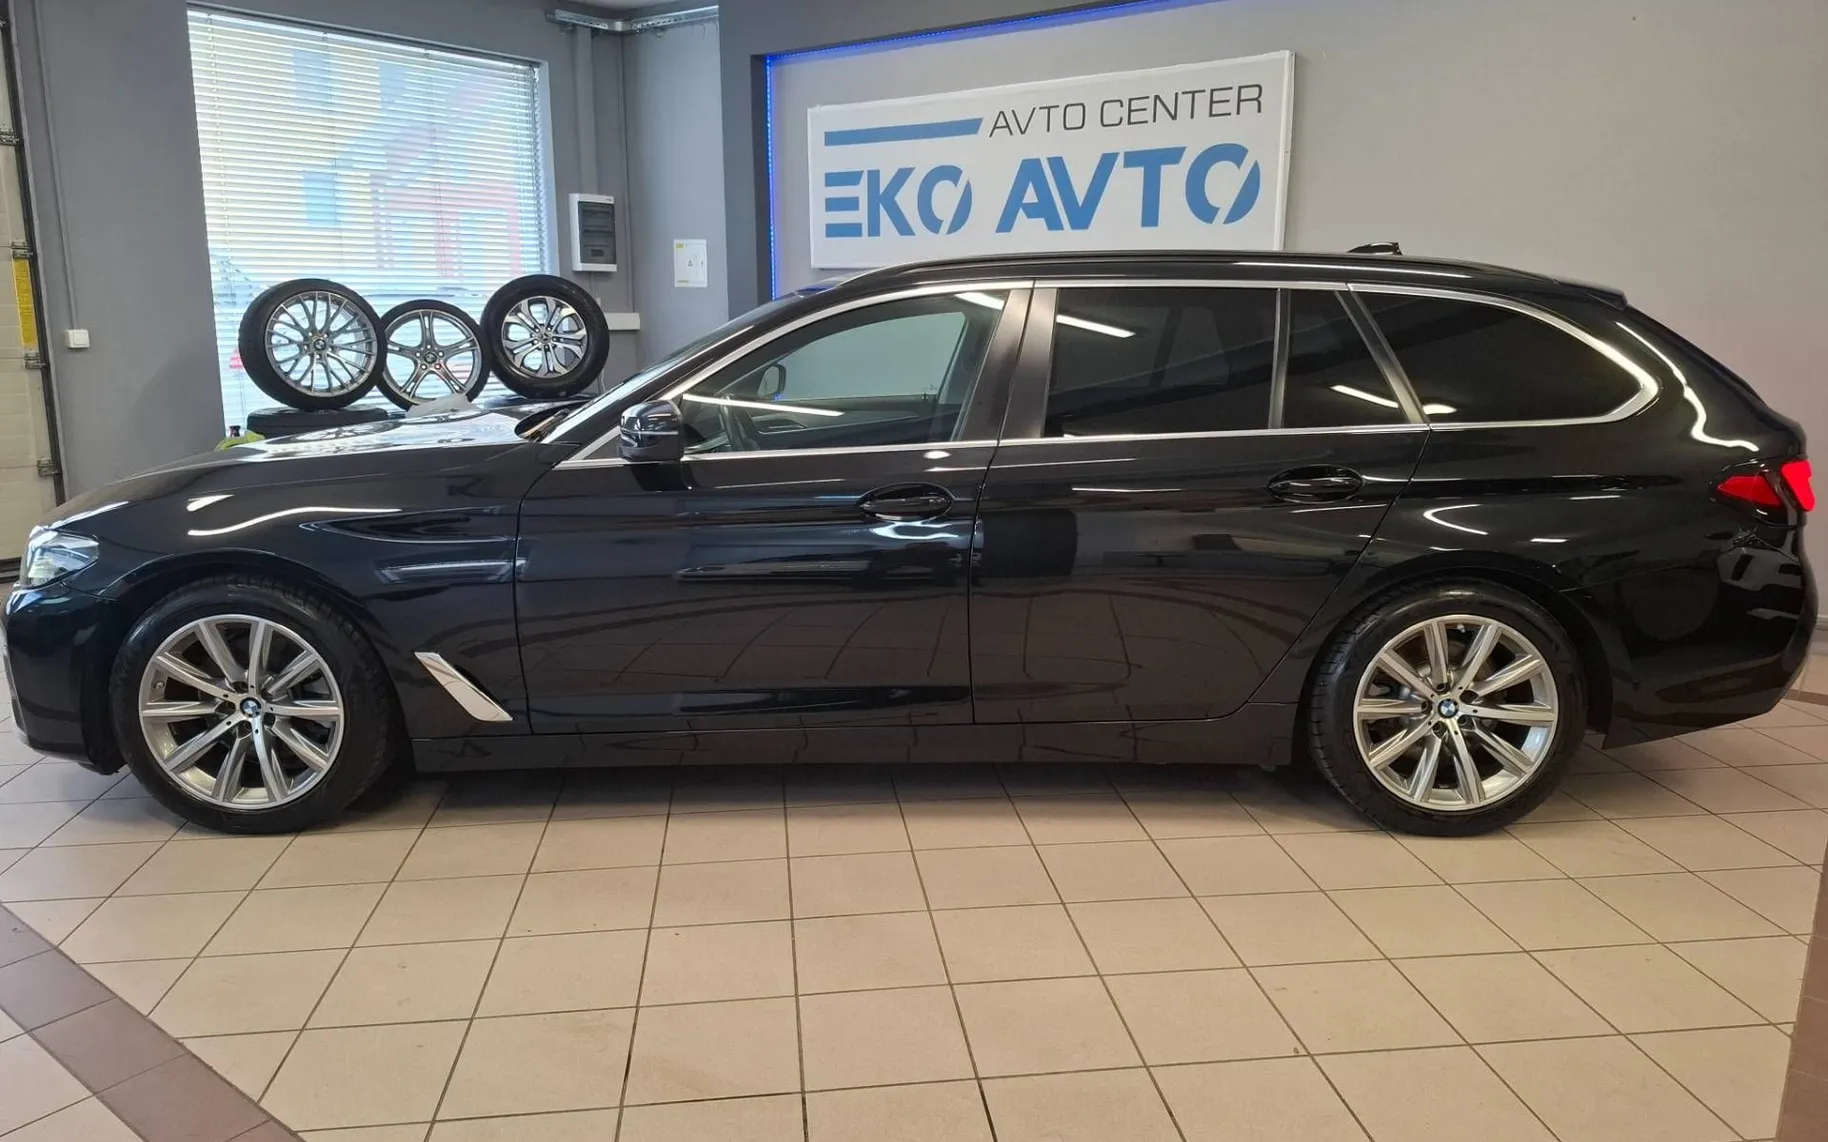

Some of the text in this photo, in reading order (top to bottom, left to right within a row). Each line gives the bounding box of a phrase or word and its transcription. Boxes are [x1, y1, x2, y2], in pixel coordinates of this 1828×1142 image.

[989, 83, 1263, 138] AVTO CENTER
[824, 143, 1261, 238] EKO AVTO
